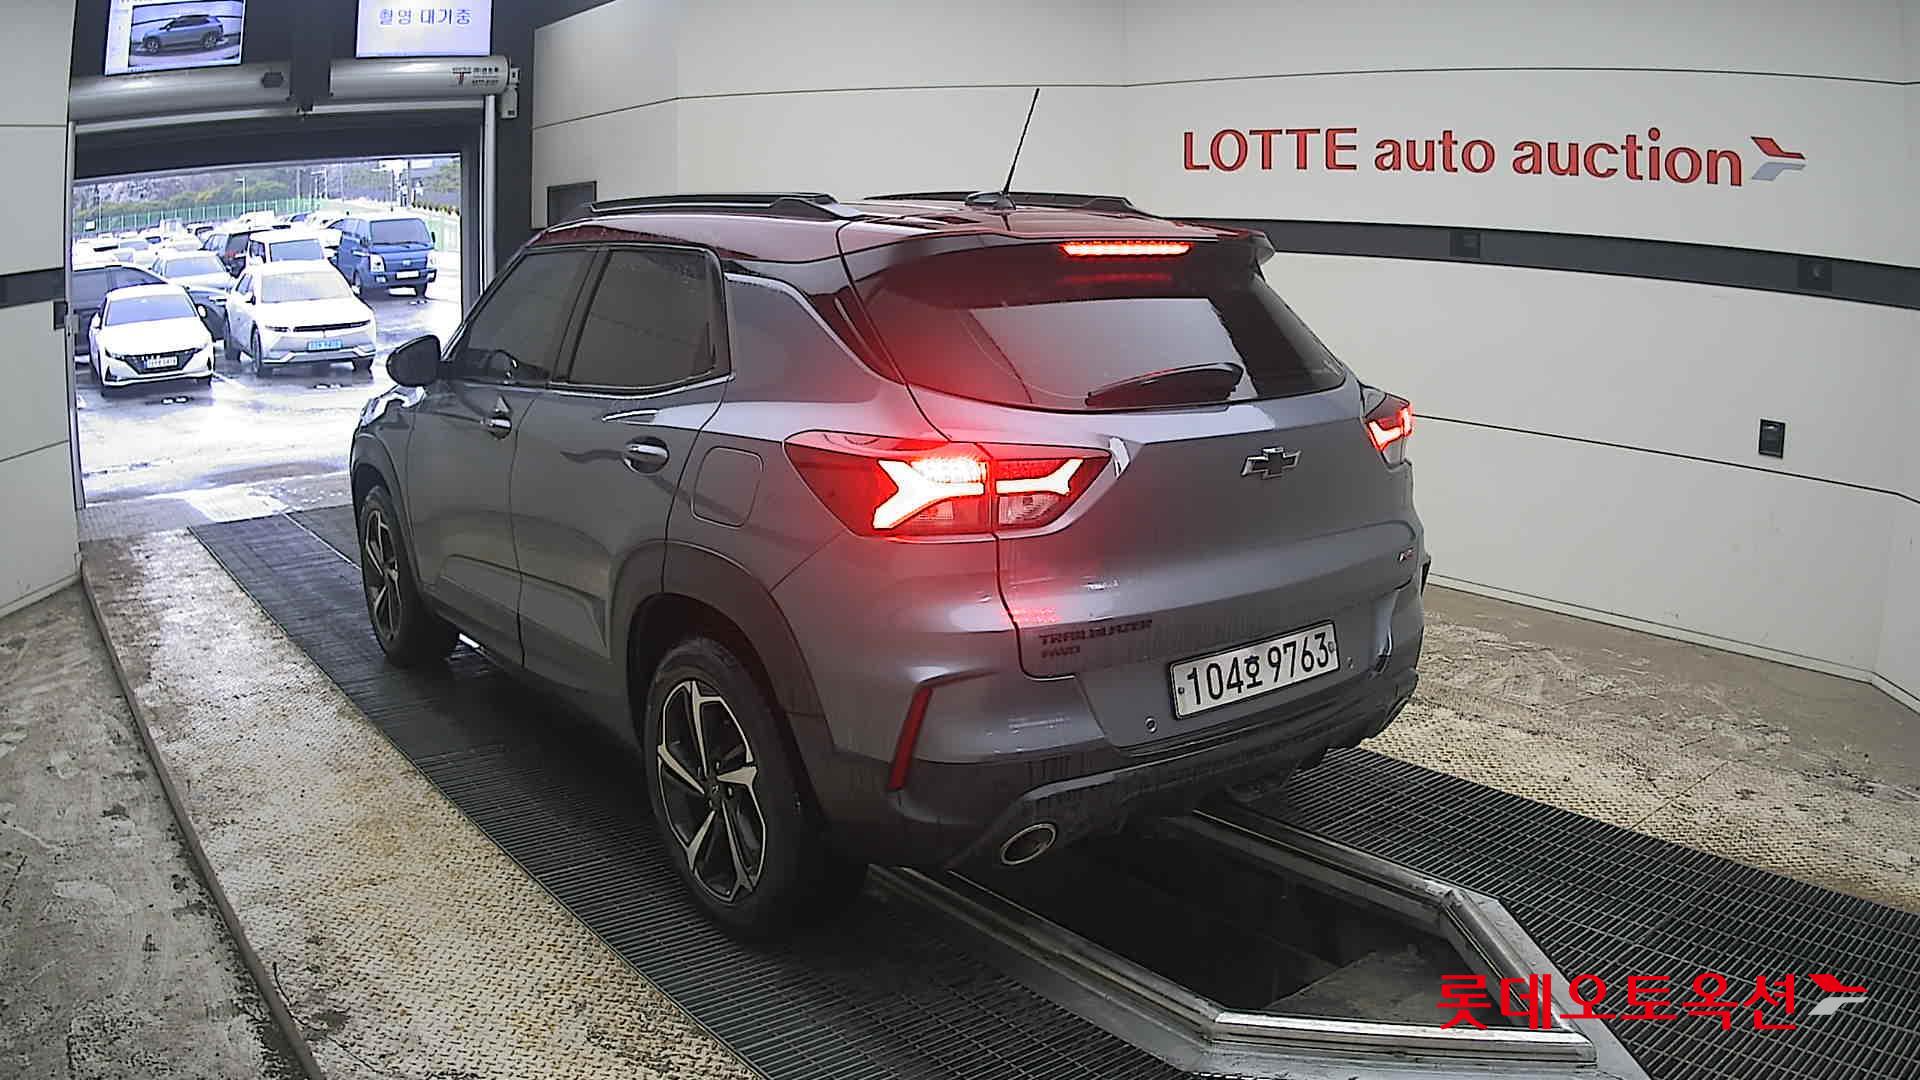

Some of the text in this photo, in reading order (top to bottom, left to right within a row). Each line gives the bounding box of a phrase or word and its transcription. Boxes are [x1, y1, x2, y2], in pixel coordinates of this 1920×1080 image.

[420, 8, 472, 25] 대기중
[1184, 127, 1743, 187] LOTTE auto auction
[1187, 632, 1329, 705] 104호 9763
